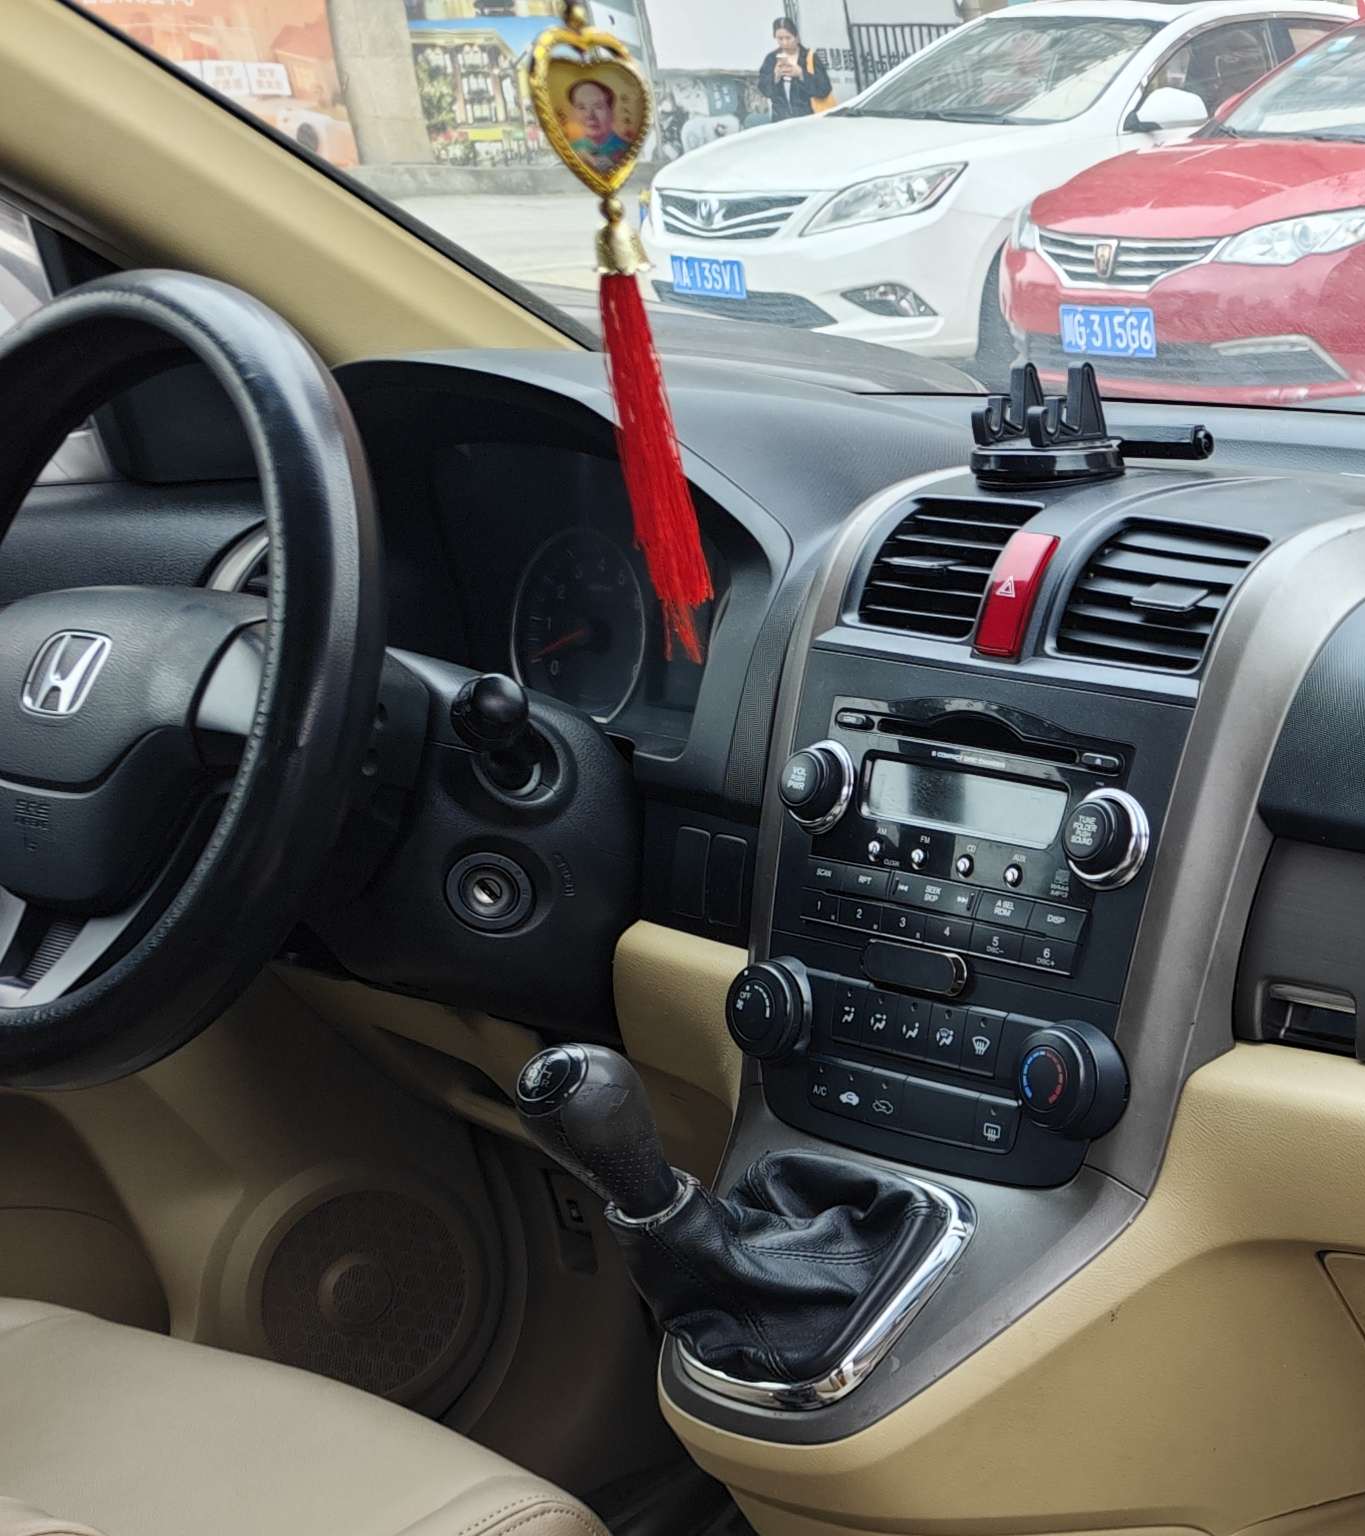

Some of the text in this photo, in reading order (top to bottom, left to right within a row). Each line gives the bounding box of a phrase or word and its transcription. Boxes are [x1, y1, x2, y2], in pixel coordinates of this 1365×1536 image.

[920, 835, 931, 844] FM
[966, 844, 977, 853] CD
[1012, 854, 1027, 863] AUX
[816, 868, 833, 878] SCAN
[858, 875, 873, 885] RPT
[925, 885, 942, 895] SEEK
[856, 908, 863, 919] 2
[899, 917, 906, 928] 3
[1046, 914, 1066, 924] DISP
[943, 926, 951, 936] 4
[992, 936, 999, 947] 5
[1043, 948, 1050, 958] 6
[740, 991, 752, 1000] OFF
[813, 1084, 827, 1097] A/C
